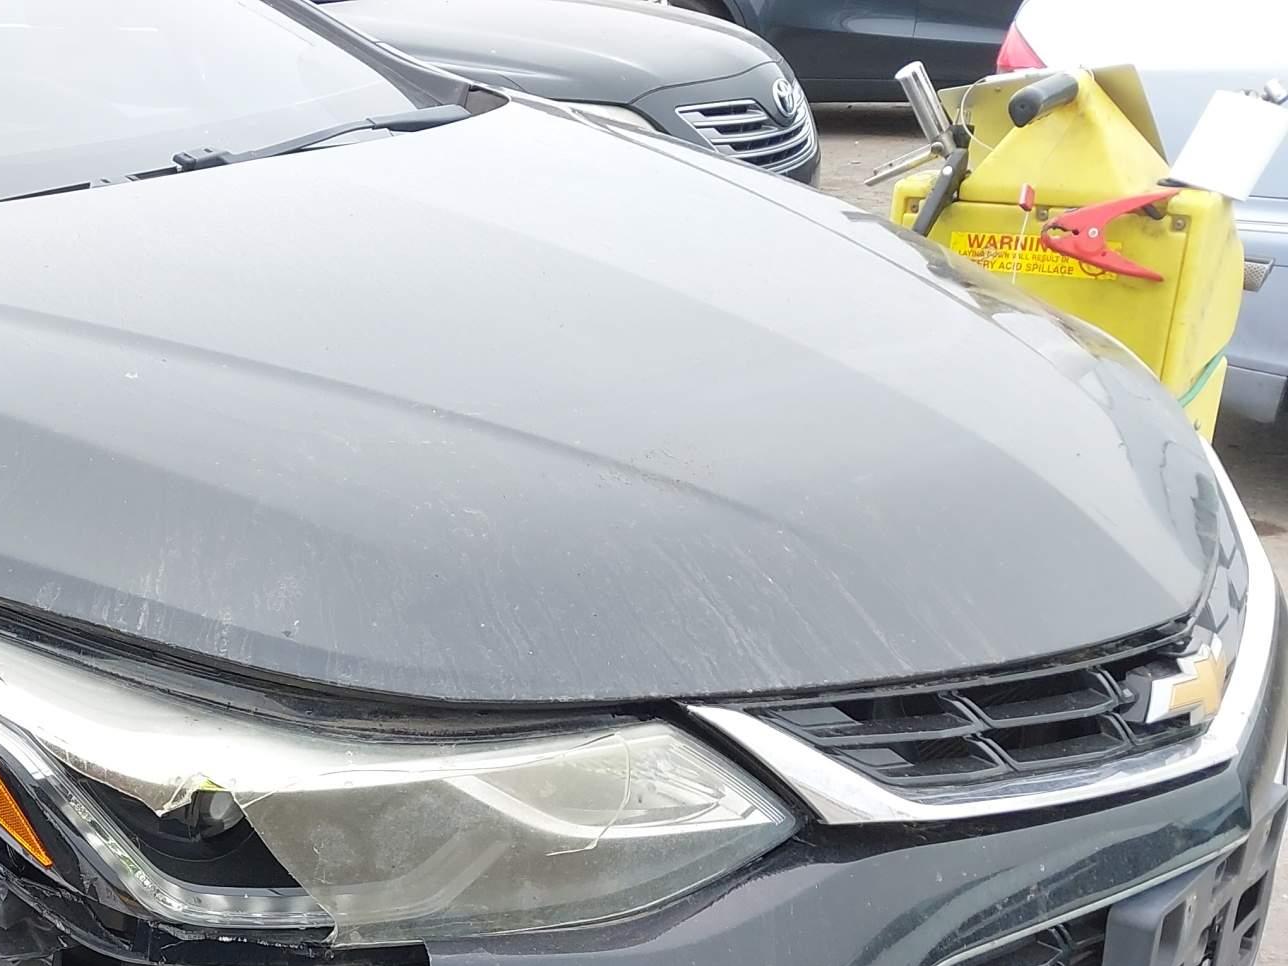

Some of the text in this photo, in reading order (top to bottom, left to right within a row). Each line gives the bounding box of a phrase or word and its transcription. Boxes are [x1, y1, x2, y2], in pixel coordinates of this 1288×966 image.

[967, 233, 1053, 252] WARNIN
[998, 262, 1023, 271] ACID
[1025, 263, 1074, 275] SPILLAGE
